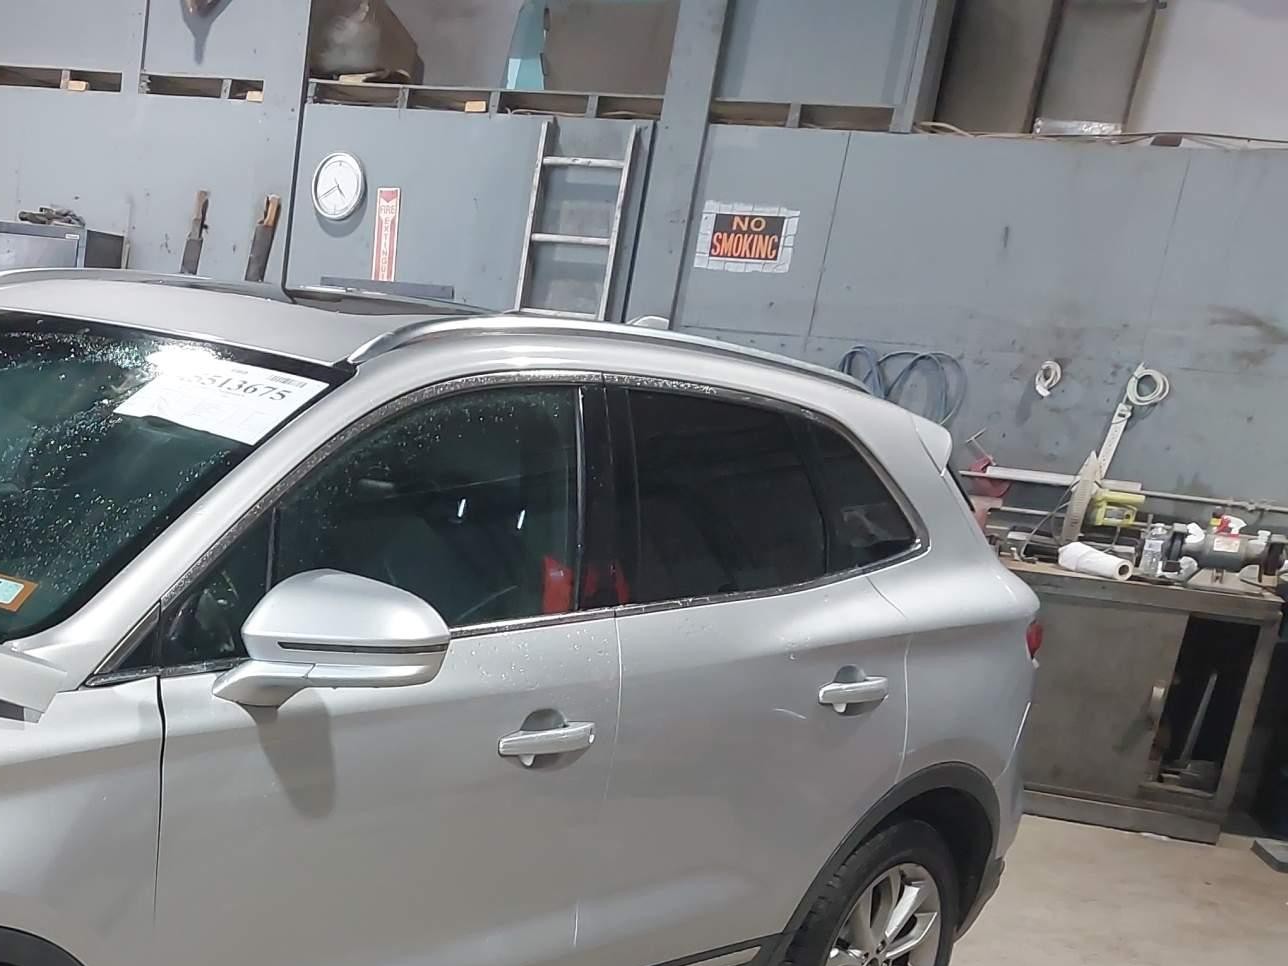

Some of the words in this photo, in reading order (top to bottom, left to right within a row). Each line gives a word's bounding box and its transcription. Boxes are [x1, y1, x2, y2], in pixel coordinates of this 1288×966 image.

[380, 204, 397, 215] FIRE
[732, 216, 766, 231] NO
[711, 231, 779, 259] SMOKING
